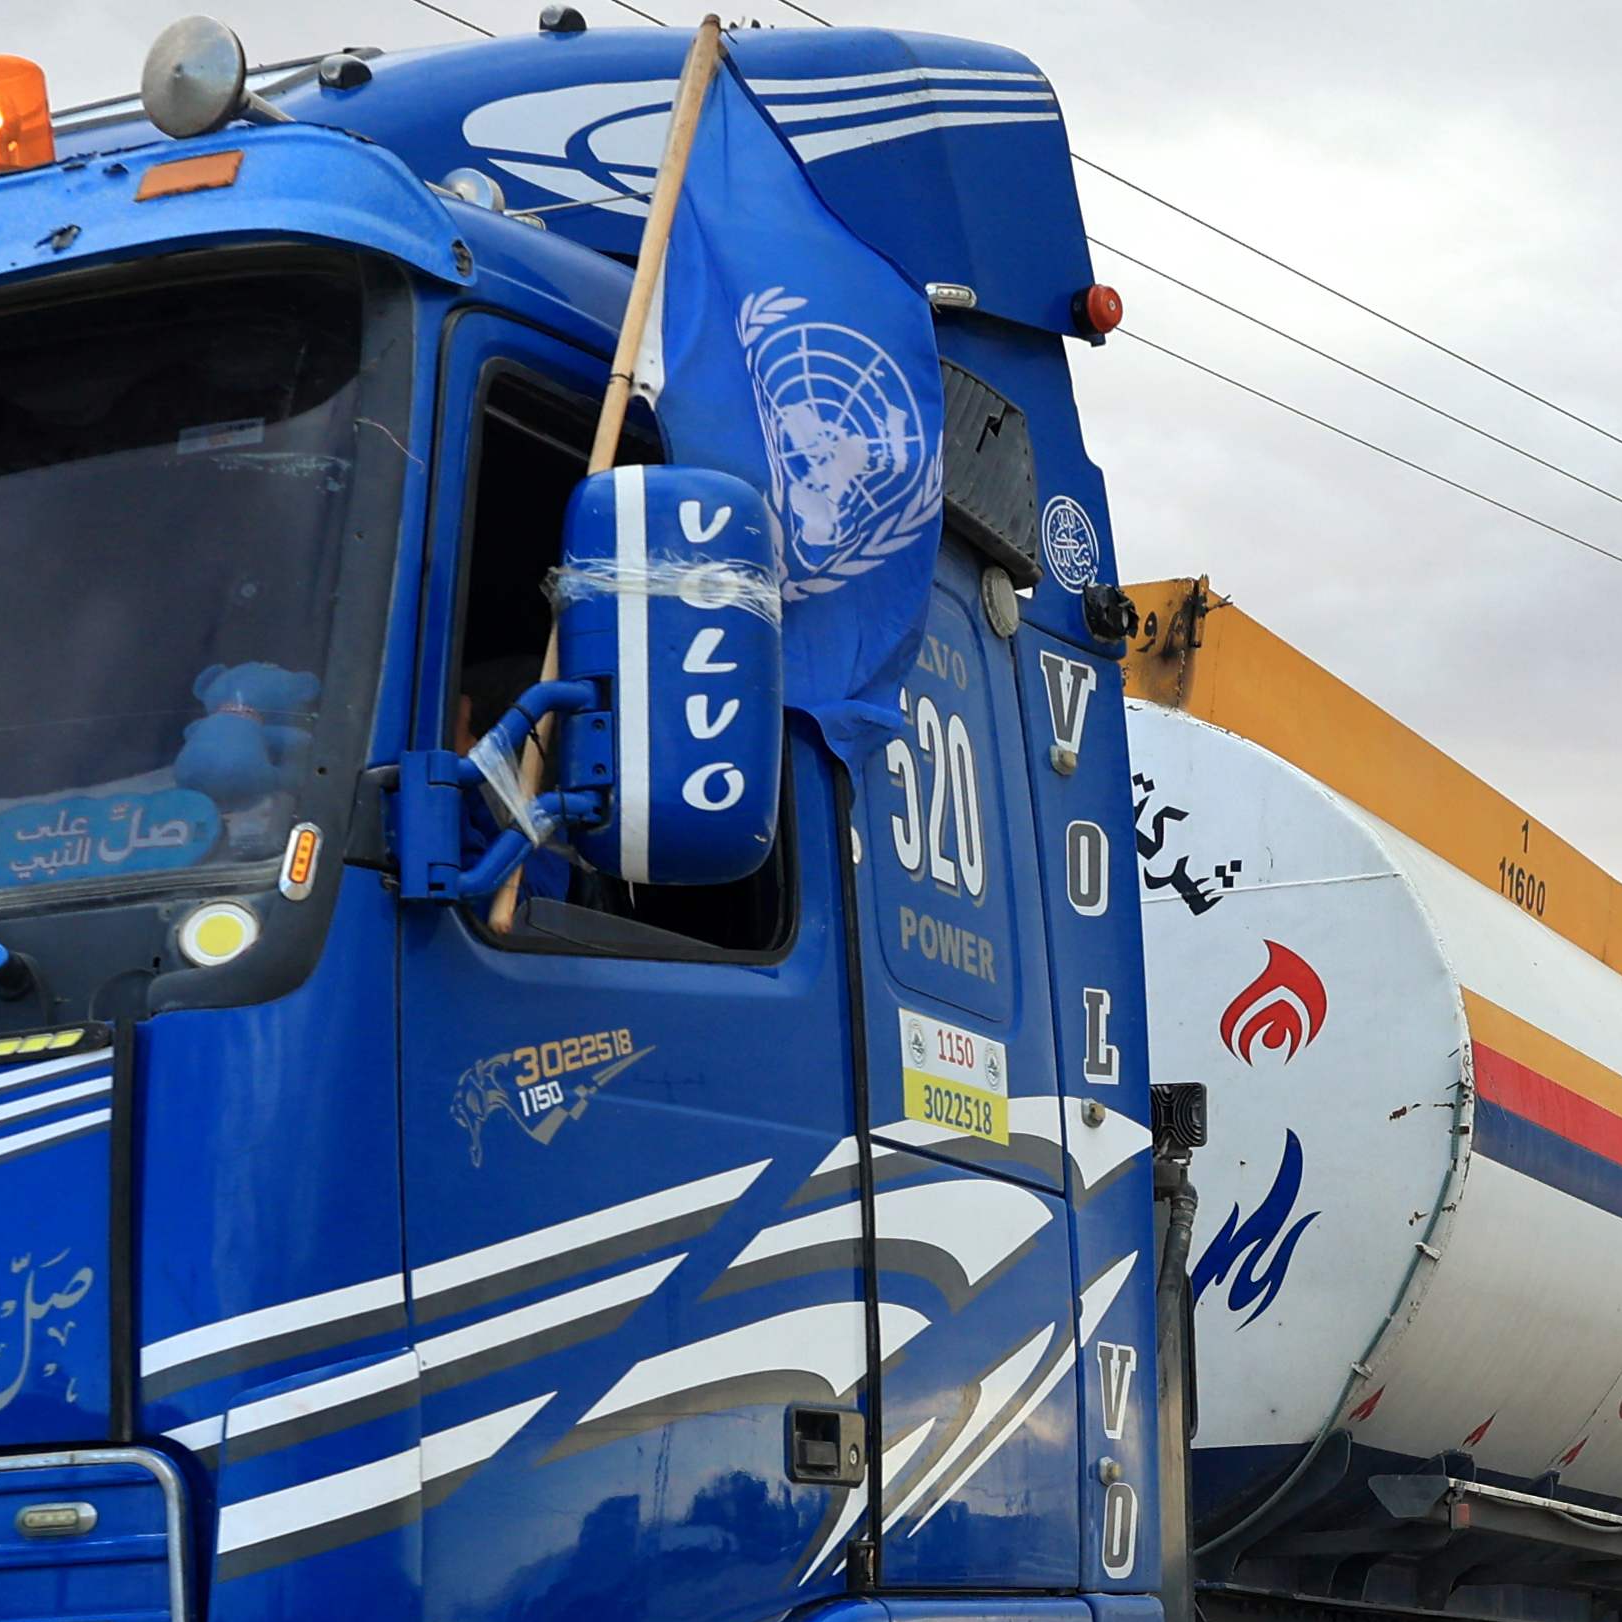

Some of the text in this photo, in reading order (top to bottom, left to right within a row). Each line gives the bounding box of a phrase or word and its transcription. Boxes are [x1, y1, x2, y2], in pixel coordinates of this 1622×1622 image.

[679, 500, 746, 811] VOLVO
[1520, 819, 1530, 854] 1
[1498, 856, 1546, 917] 11600
[900, 905, 996, 984] POWER
[513, 1028, 633, 1087] 3022518
[937, 1028, 975, 1069] 1150
[519, 1080, 564, 1117] 1150
[923, 1084, 993, 1136] 3022518
